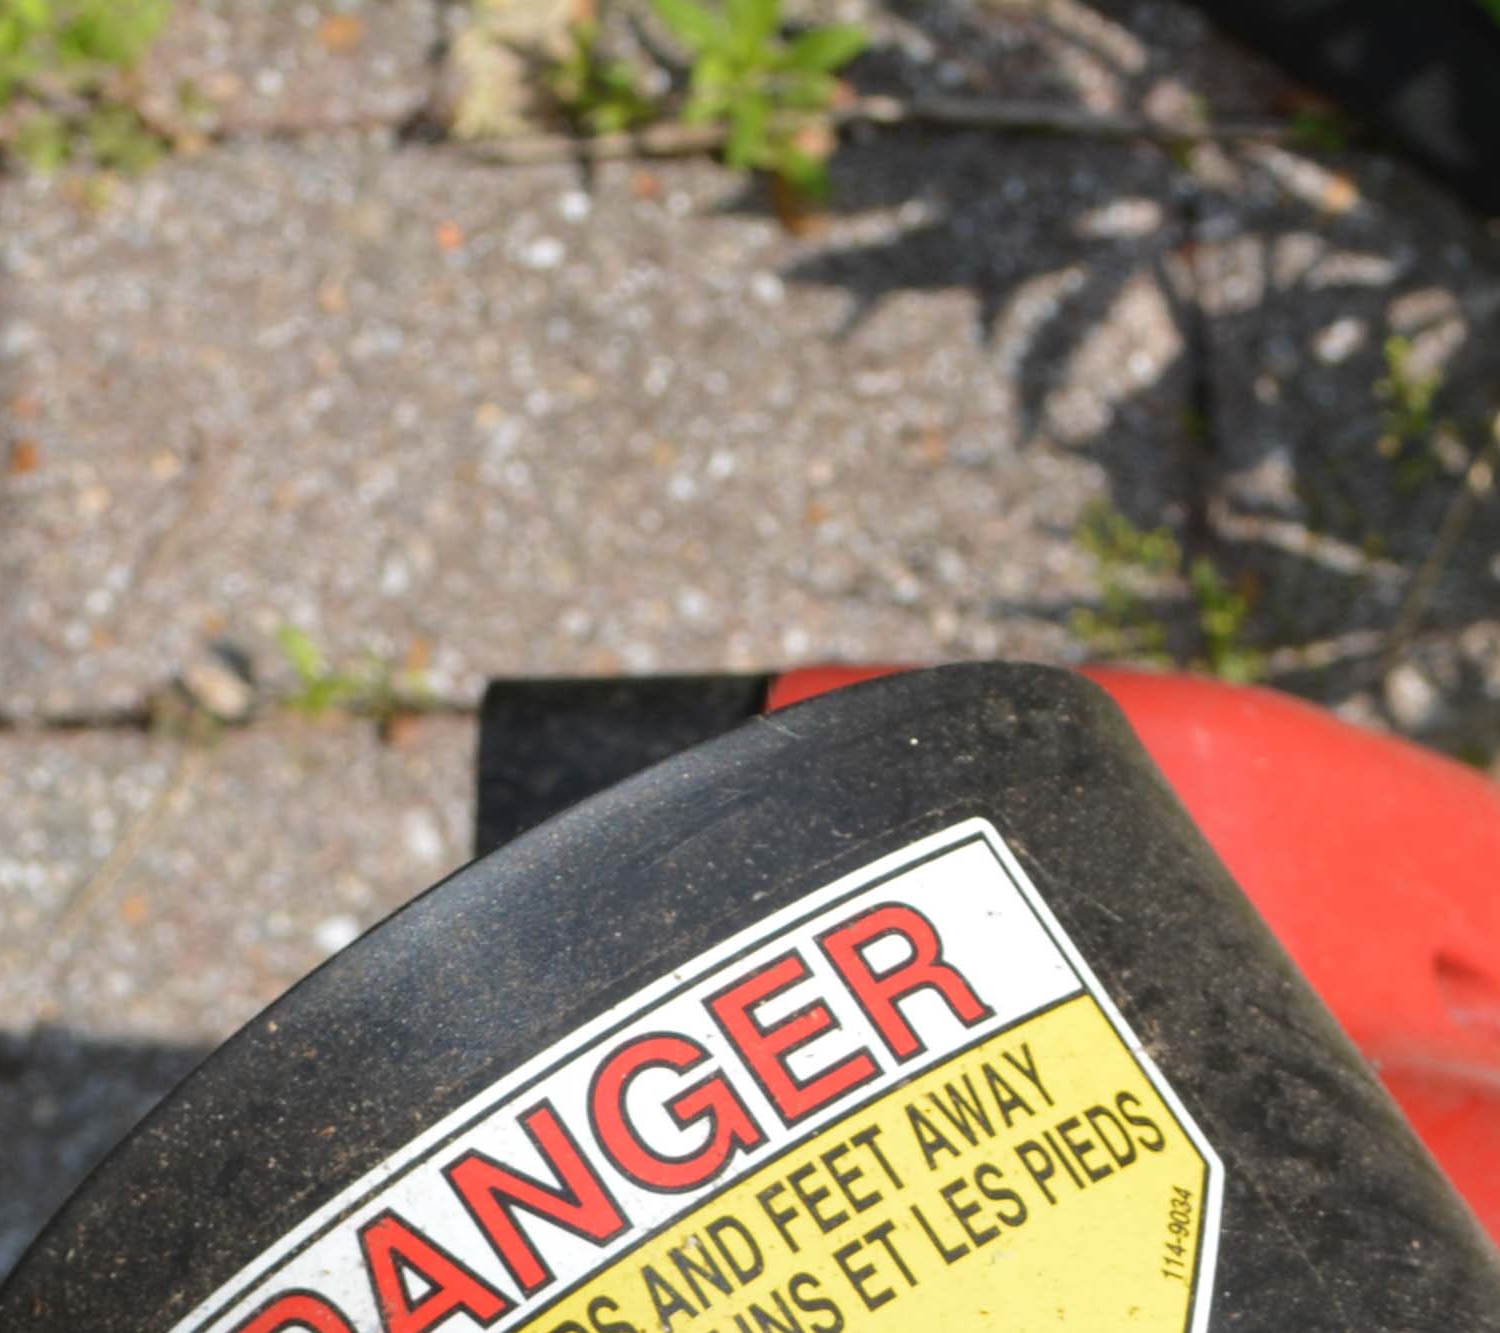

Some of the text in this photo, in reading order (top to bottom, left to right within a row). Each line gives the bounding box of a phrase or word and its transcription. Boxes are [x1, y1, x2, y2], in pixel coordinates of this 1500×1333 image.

[756, 1124, 905, 1254] FEET
[904, 1043, 1056, 1171] AWAY
[833, 1219, 919, 1312] ET
[910, 1162, 1028, 1265] LES
[1015, 1090, 1167, 1205] PIEDS
[1161, 1184, 1193, 1280] 114-9034
